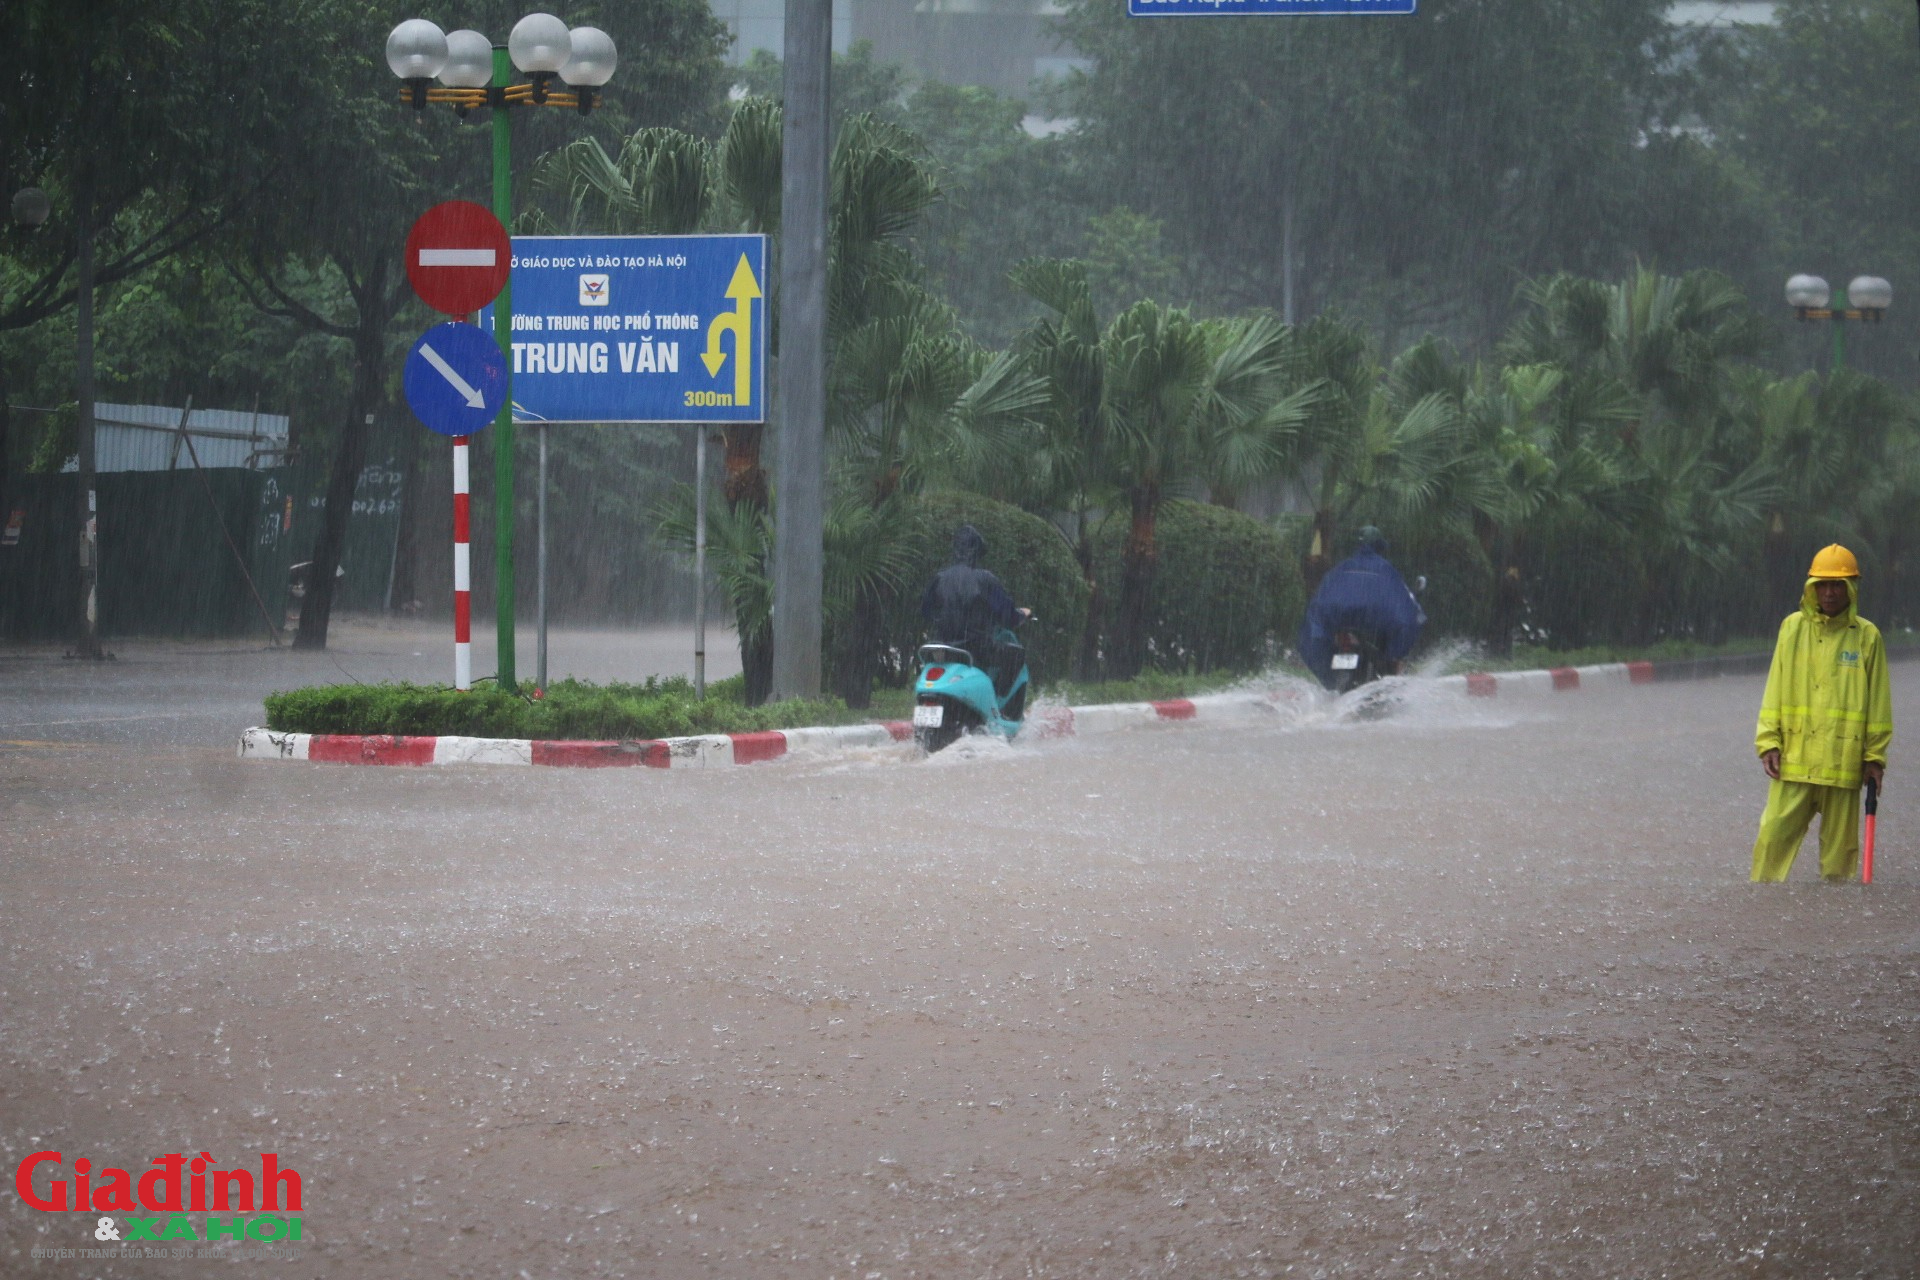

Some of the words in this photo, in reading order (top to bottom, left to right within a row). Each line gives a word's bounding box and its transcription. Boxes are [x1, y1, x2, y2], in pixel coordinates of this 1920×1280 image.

[521, 255, 550, 268] GIÁO
[552, 257, 576, 271] DỤC
[578, 254, 594, 268] VÀ
[596, 254, 621, 268] ĐÀO
[623, 256, 646, 270] TẠO
[648, 254, 664, 267] HÀ
[666, 253, 687, 270] NỘI
[546, 315, 590, 331] TRUNG
[593, 314, 621, 333] HỌC
[624, 310, 651, 331] PHỔ
[655, 312, 699, 330] THÔNG
[511, 341, 609, 374] TRUNG
[617, 335, 679, 373] VĂN
[684, 391, 733, 407] 300m
